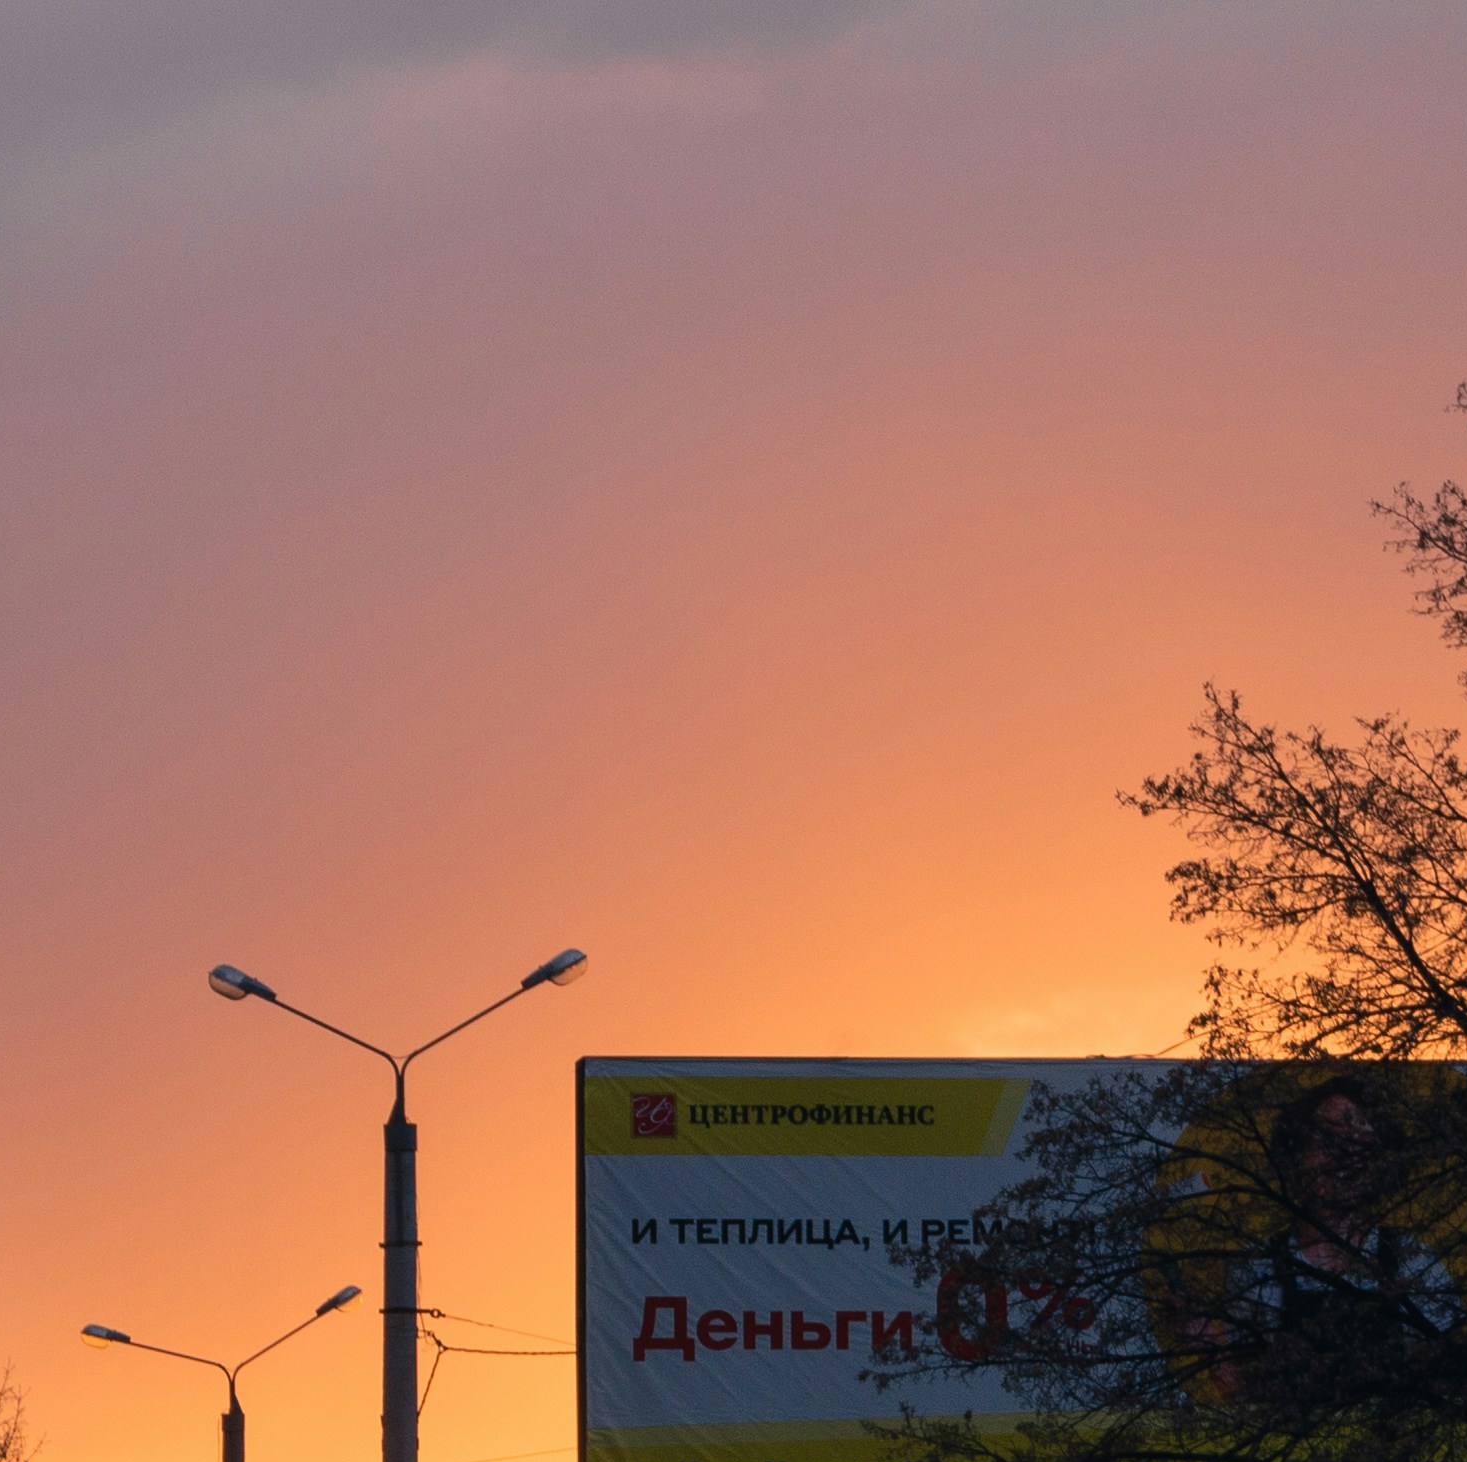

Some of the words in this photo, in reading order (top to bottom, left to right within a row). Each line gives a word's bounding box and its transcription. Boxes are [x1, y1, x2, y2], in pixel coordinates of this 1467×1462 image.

[689, 1103, 935, 1129] ЦЕНТРОФИНАНС
[631, 1218, 657, 1244] И
[669, 1218, 871, 1250] ТЕПЛИЦА,
[882, 1218, 908, 1245] И
[632, 1296, 913, 1361] Деньги
